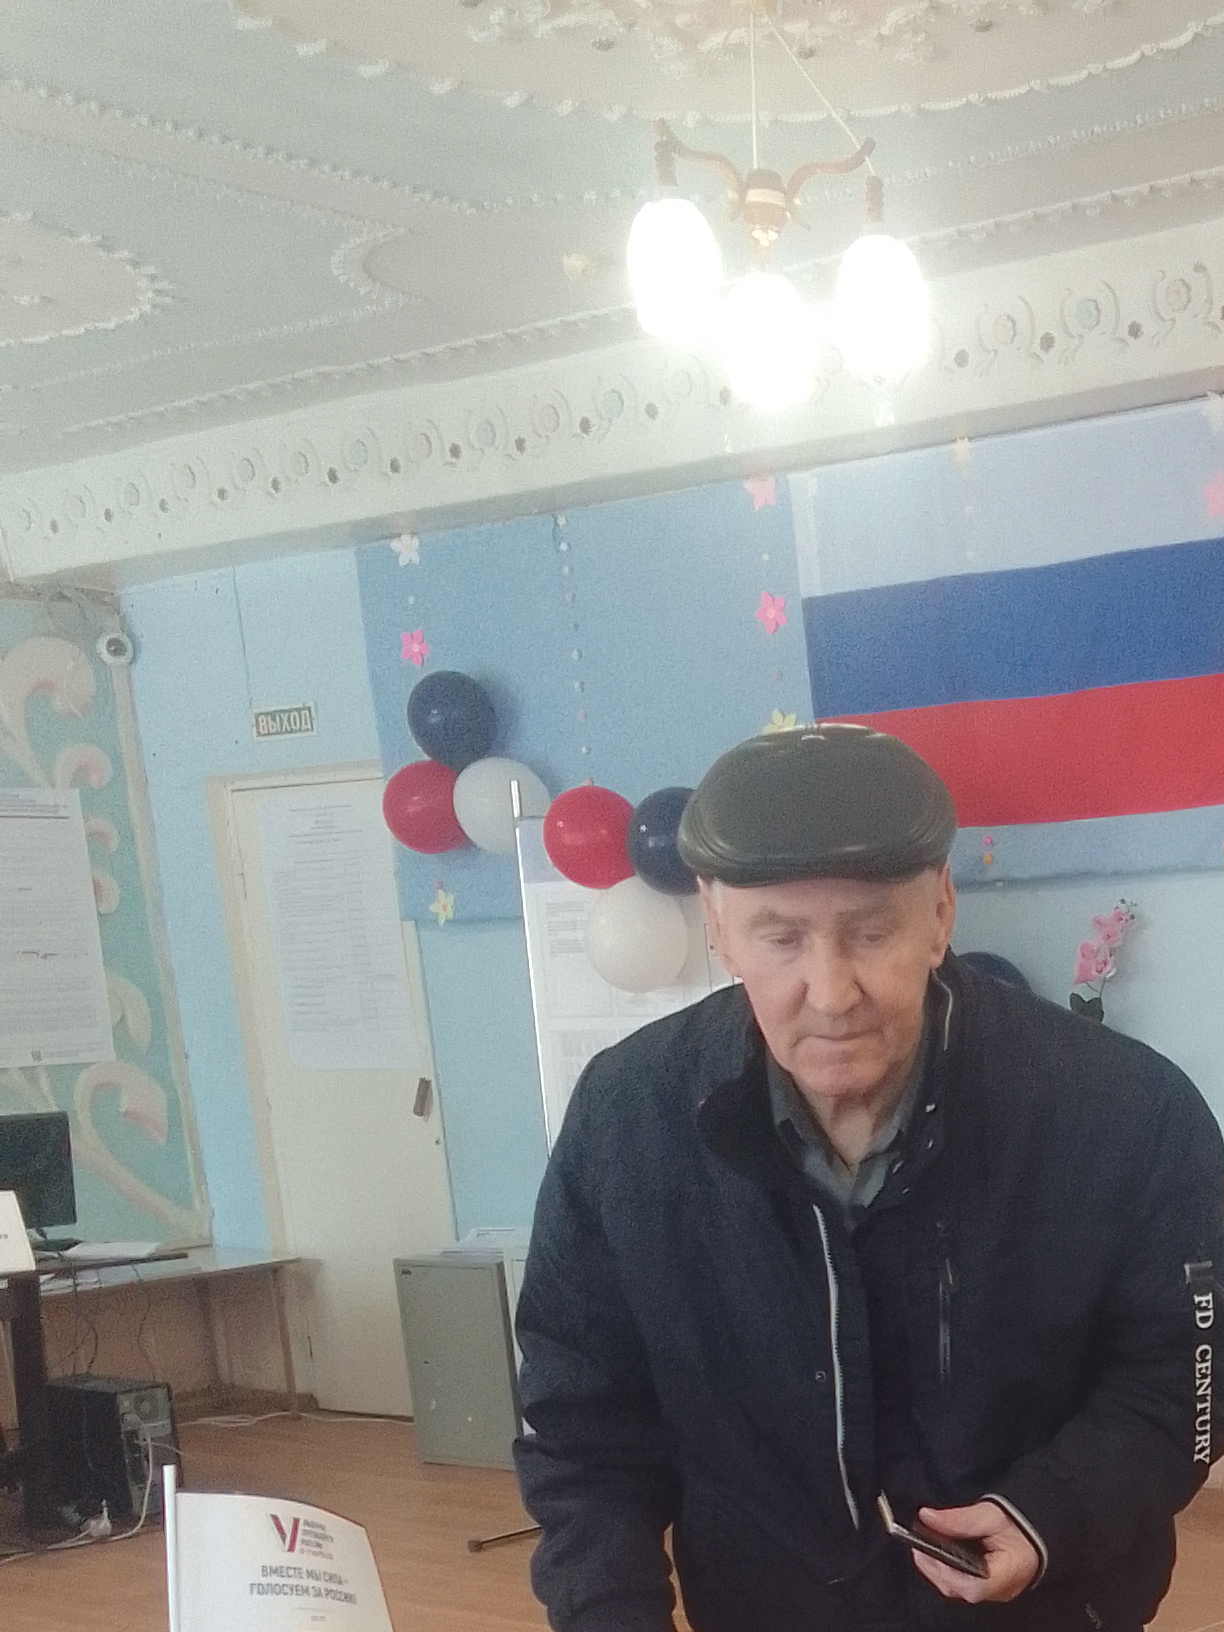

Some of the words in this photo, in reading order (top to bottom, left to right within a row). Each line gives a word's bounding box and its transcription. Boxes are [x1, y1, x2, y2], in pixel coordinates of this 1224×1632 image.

[257, 709, 312, 735] ВЫХОД
[1194, 1293, 1214, 1329] FD
[1194, 1345, 1213, 1463] CENTURY
[261, 1565, 304, 1579] ВМЕСТЕ
[305, 1568, 322, 1582] МЫ
[250, 1583, 310, 1597] ГОЛОСУЕМ
[312, 1585, 323, 1598] ЗА
